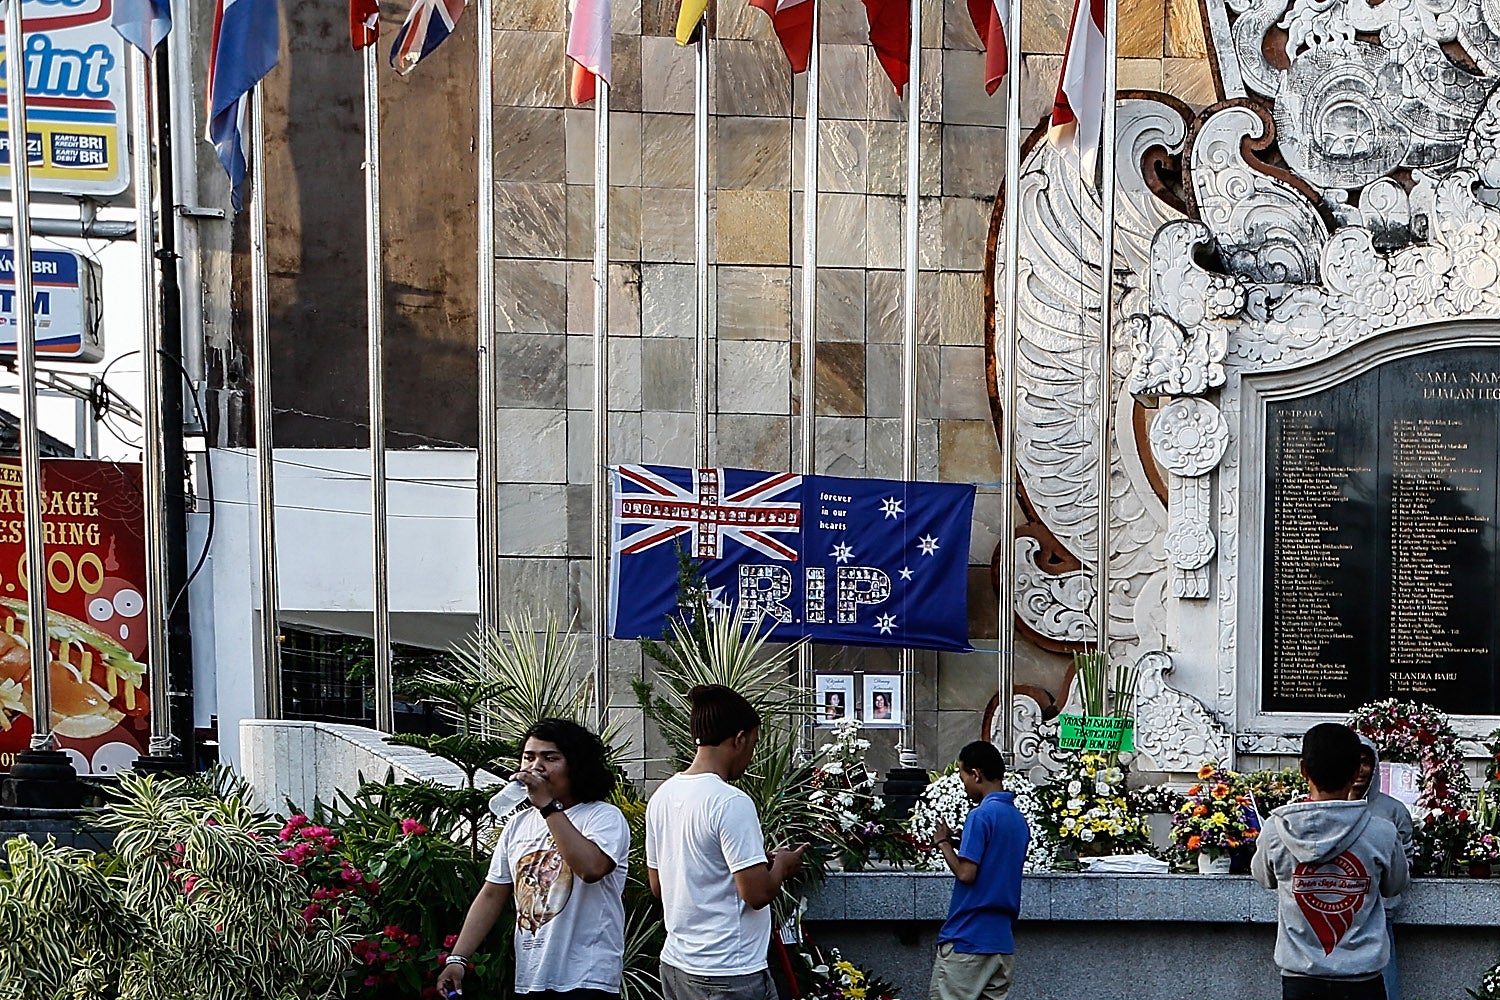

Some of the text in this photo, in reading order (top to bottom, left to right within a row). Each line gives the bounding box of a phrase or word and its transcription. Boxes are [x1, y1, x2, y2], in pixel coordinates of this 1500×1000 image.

[79, 136, 103, 149] BRI
[80, 150, 103, 164] BRI
[32, 261, 57, 274] BRI
[820, 492, 852, 503] forever
[821, 506, 847, 517] in our
[819, 520, 847, 531] hearts
[1390, 672, 1457, 681] SELANDIA BARU
